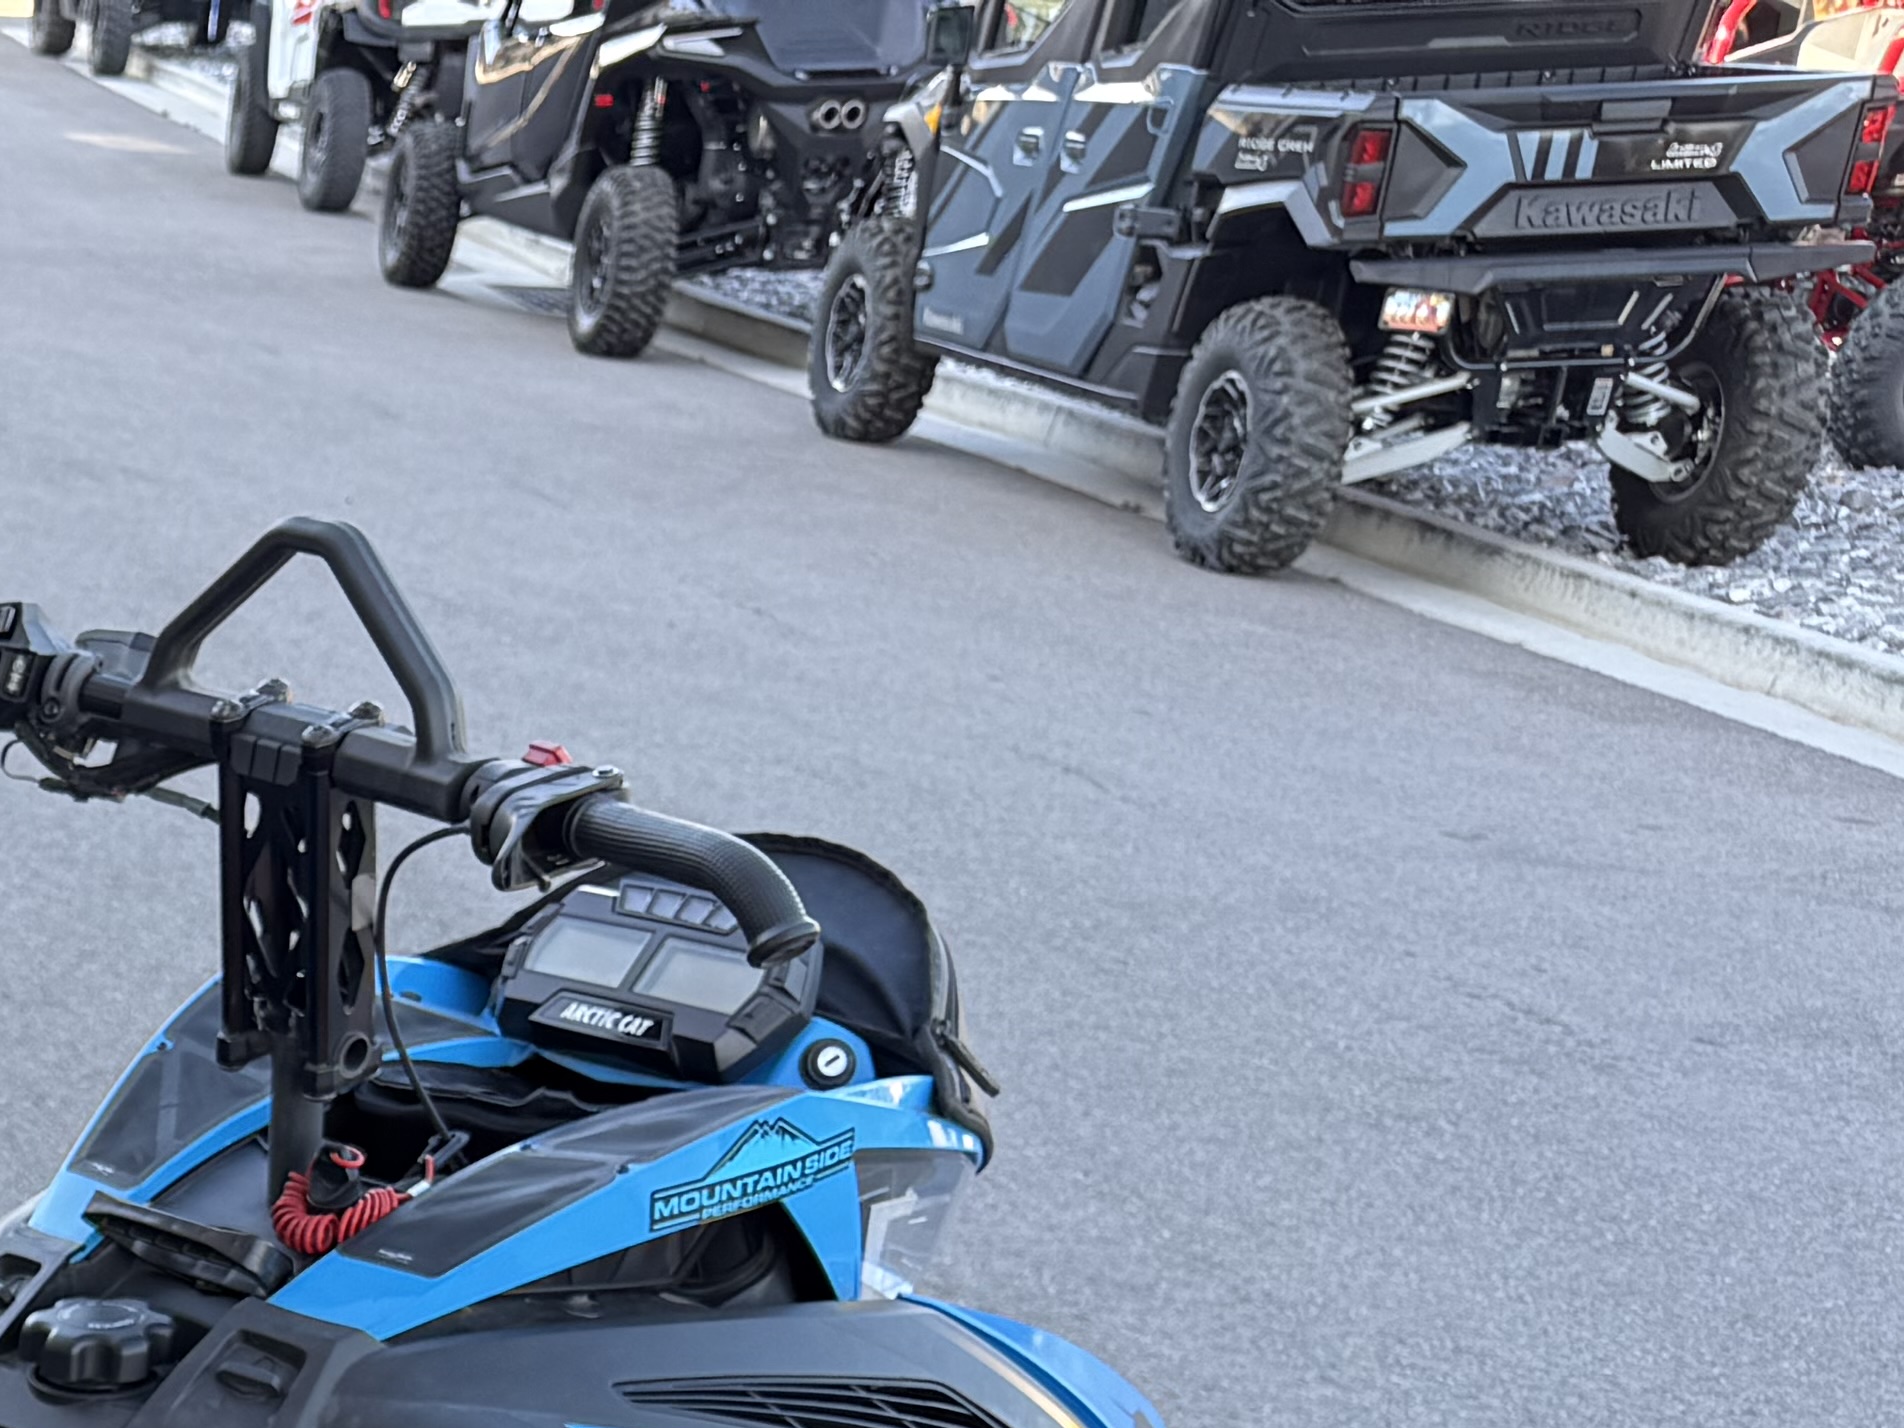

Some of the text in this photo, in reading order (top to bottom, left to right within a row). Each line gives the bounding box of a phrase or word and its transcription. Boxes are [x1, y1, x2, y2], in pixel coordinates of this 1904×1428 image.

[1514, 189, 1703, 229] Kawasaki
[559, 1002, 654, 1036] ARCTIC CAT
[652, 1140, 854, 1221] MOUNTAIN SIDE
[701, 1174, 814, 1221] PERFORMANCE
